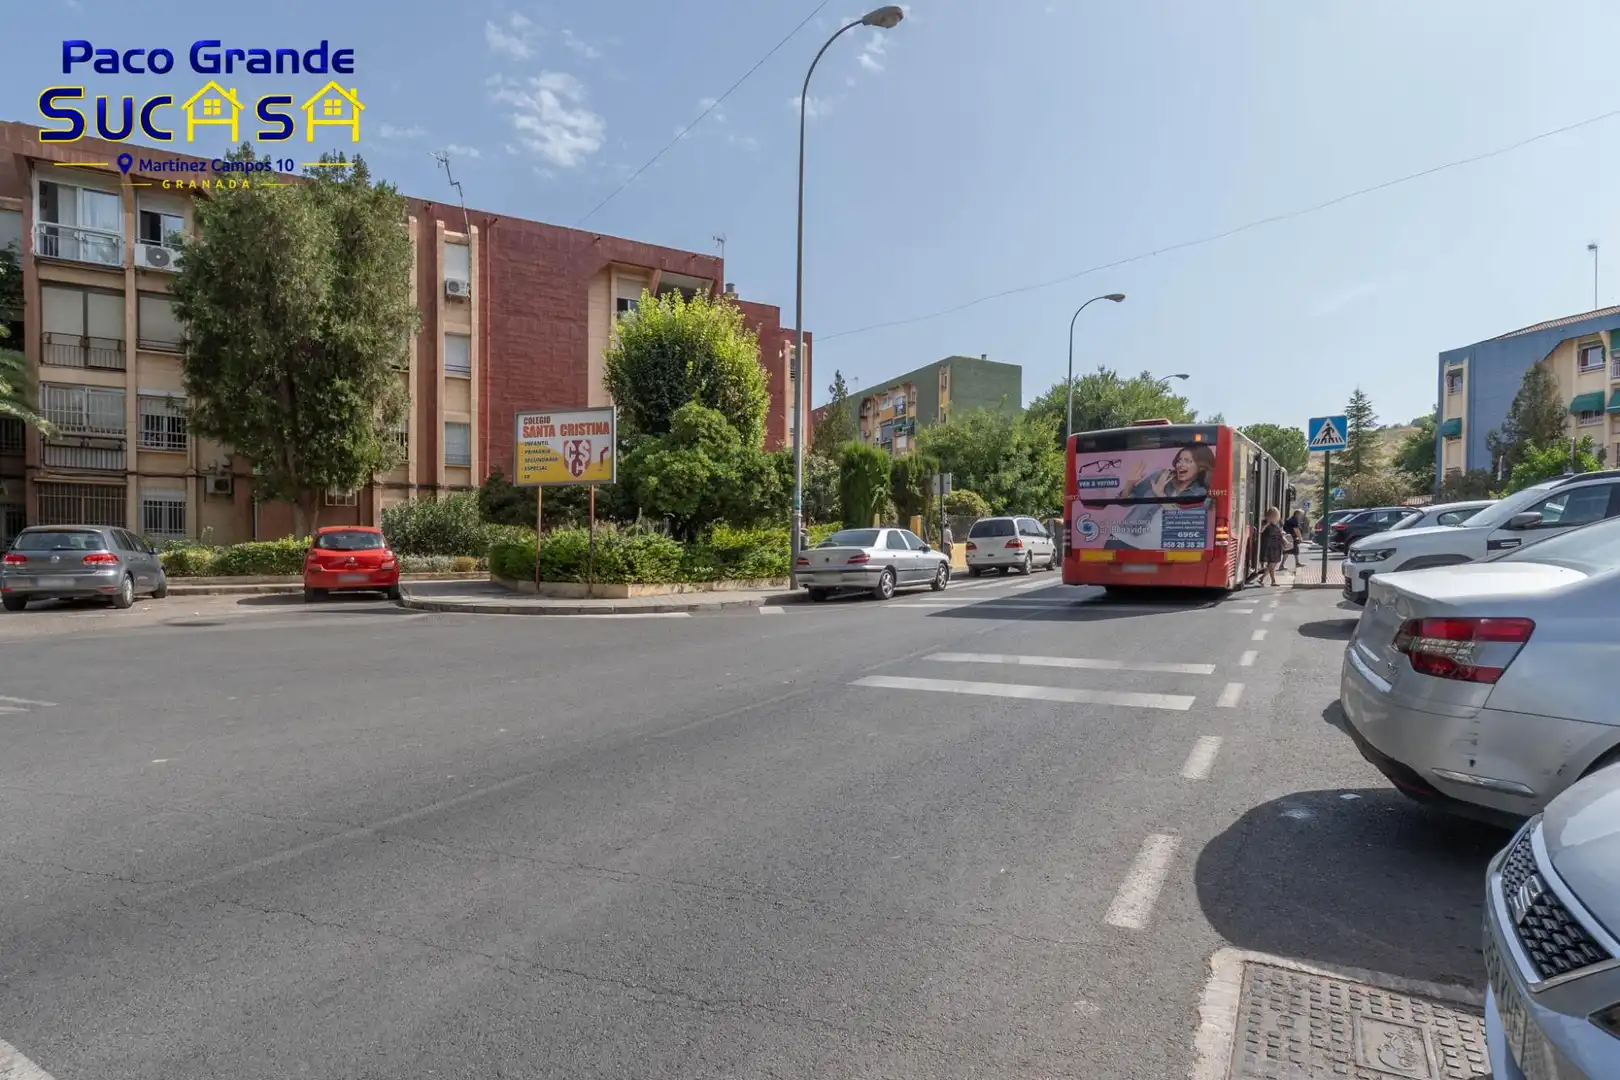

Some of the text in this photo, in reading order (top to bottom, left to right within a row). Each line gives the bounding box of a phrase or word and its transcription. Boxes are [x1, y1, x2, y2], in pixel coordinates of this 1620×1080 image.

[523, 416, 551, 425] COLEGIO
[522, 422, 610, 439] SANTA CRISTINA
